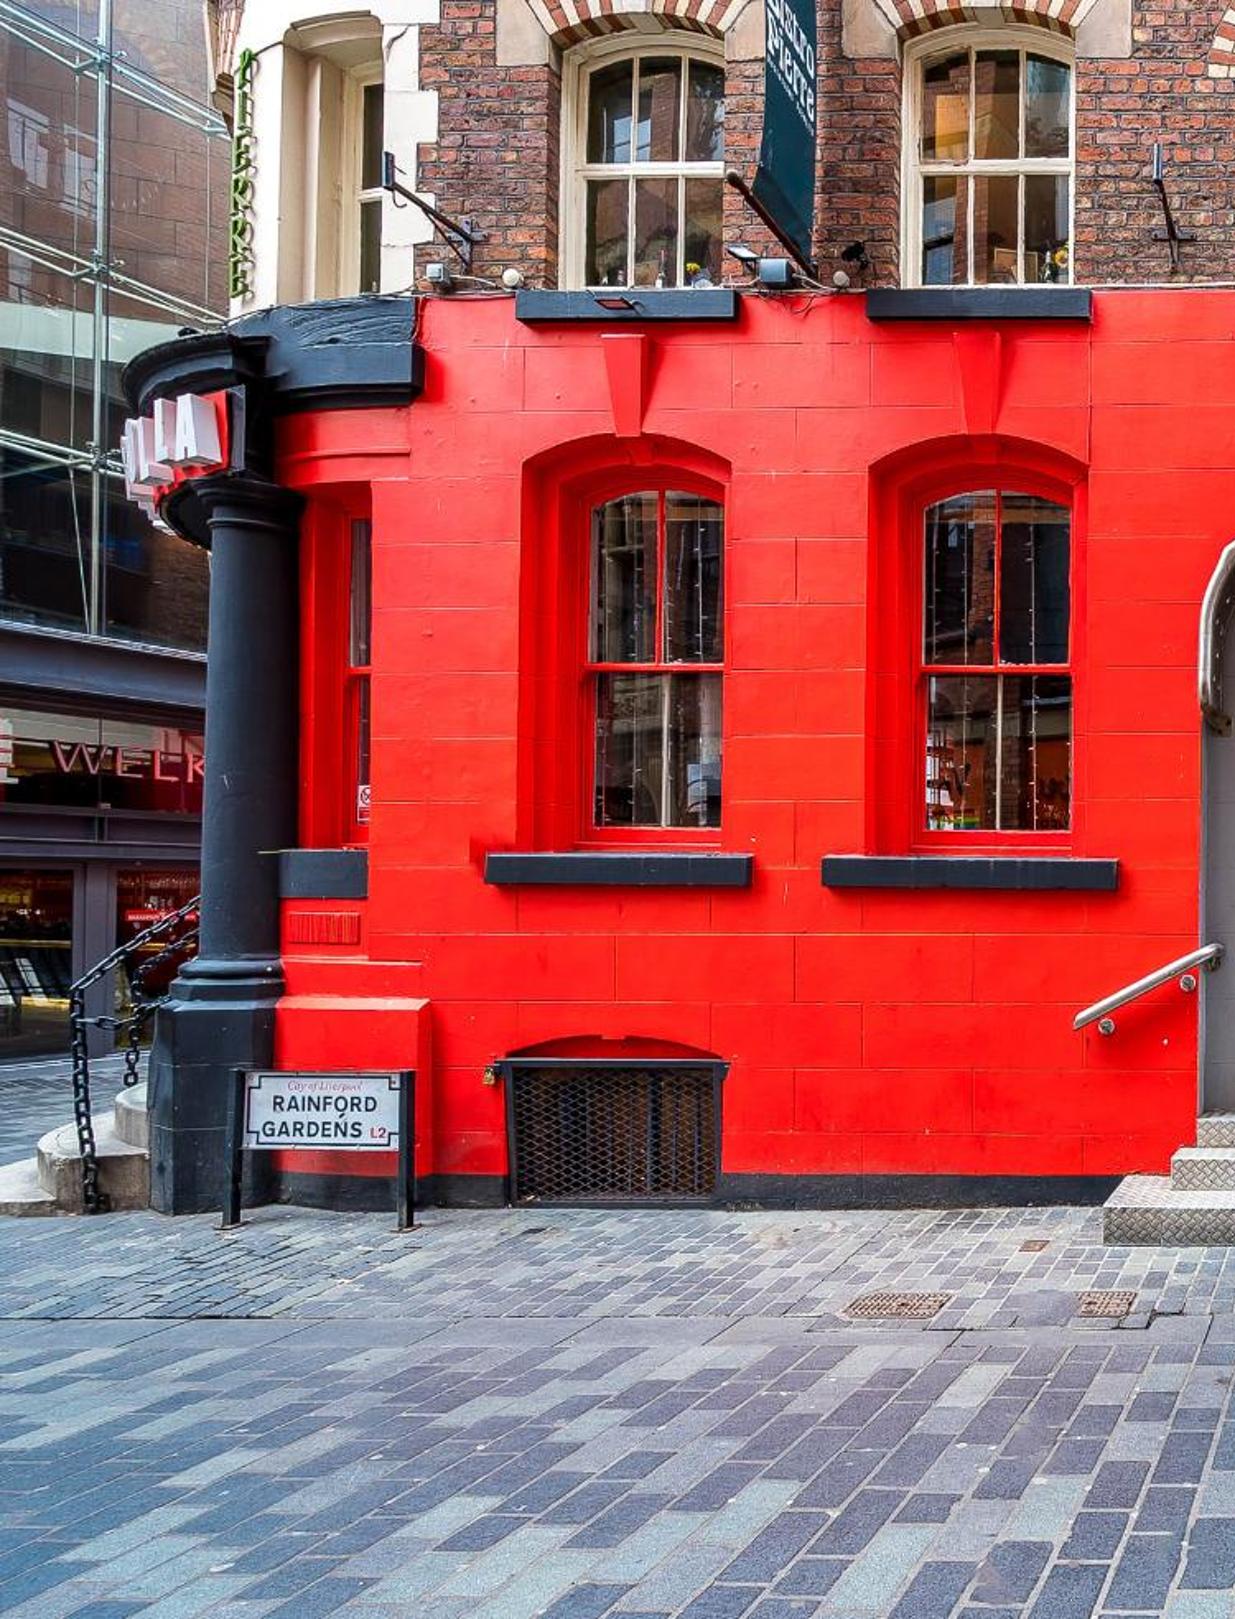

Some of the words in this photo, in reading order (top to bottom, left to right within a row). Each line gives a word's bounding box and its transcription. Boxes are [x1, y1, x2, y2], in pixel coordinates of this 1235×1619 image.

[766, 7, 814, 122] Pierre
[273, 1095, 378, 1113] RAINFORD
[262, 1120, 363, 1139] GARDENS
[370, 1127, 387, 1139] L2
